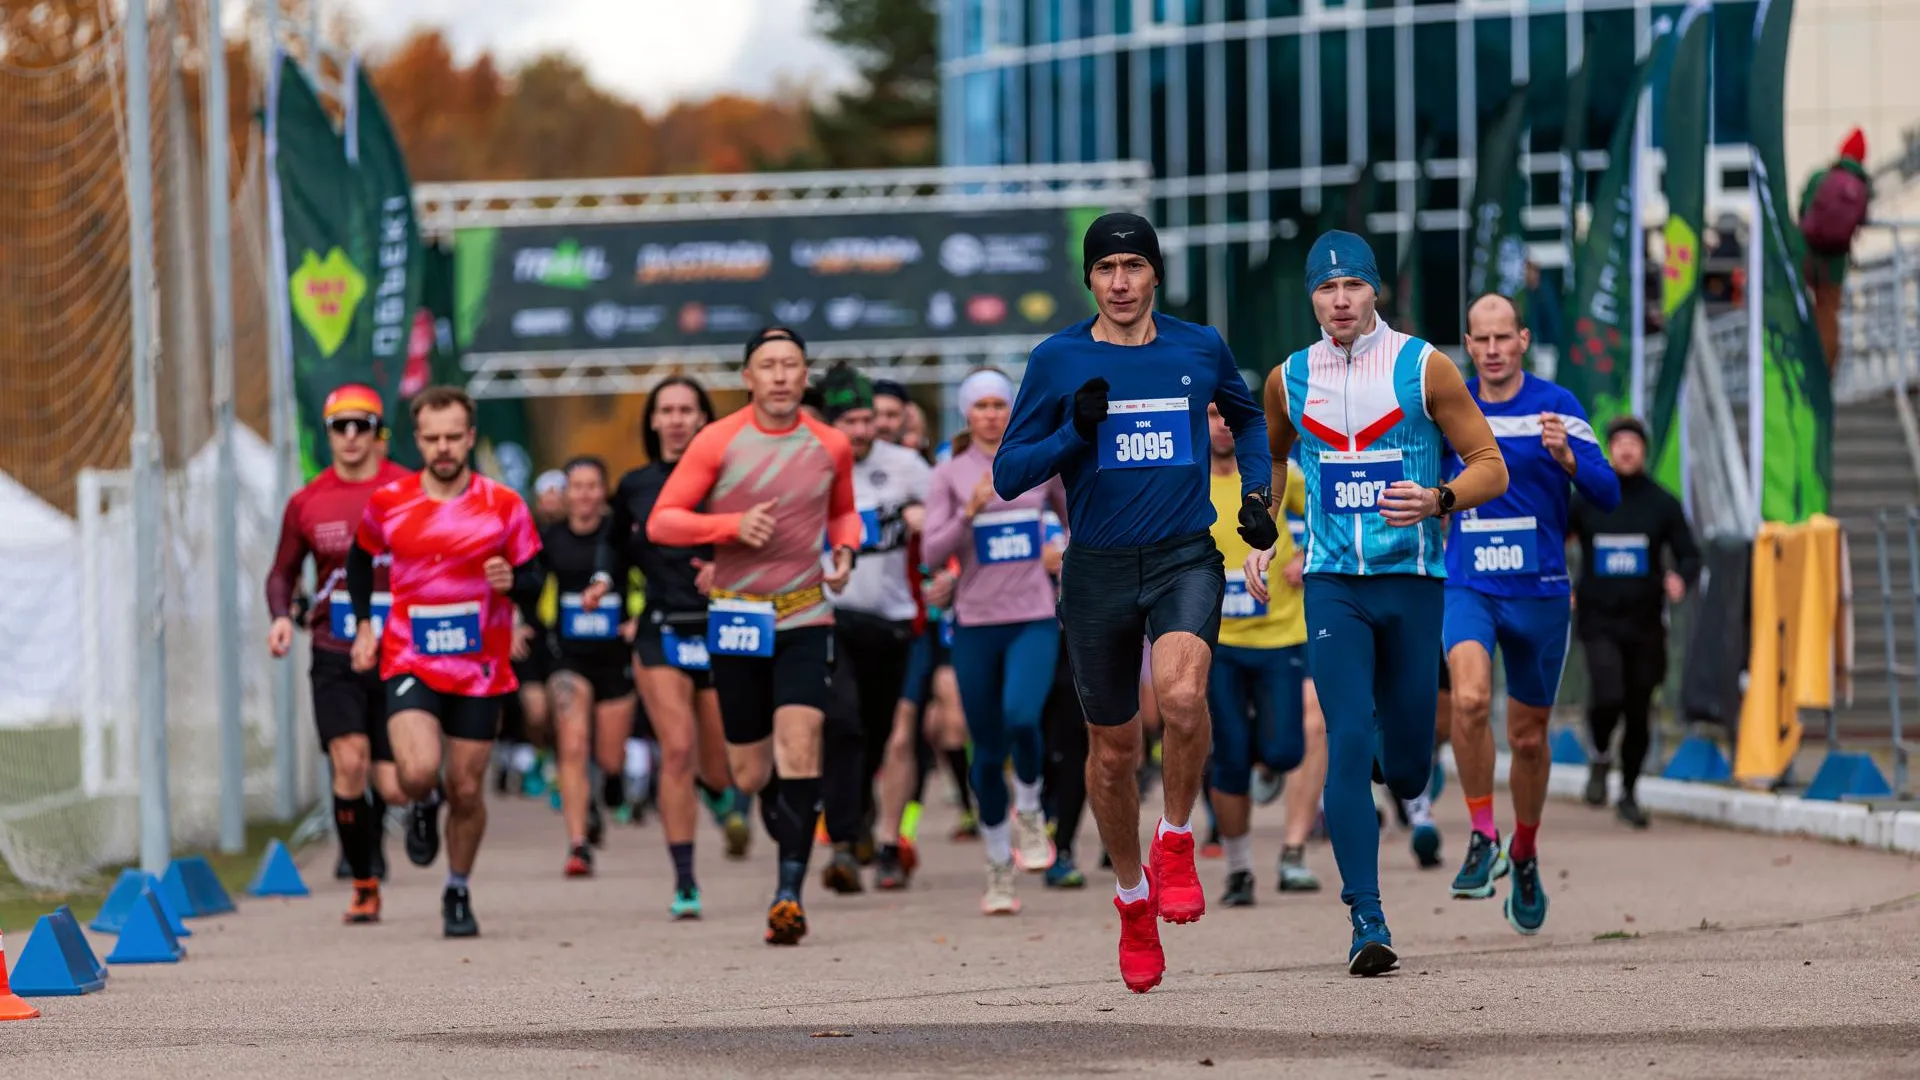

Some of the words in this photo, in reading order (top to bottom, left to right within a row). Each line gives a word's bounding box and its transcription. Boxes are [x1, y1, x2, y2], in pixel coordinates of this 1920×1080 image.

[1116, 431, 1173, 462] 3095
[1335, 480, 1386, 508] 3097
[1474, 544, 1523, 571] 3060
